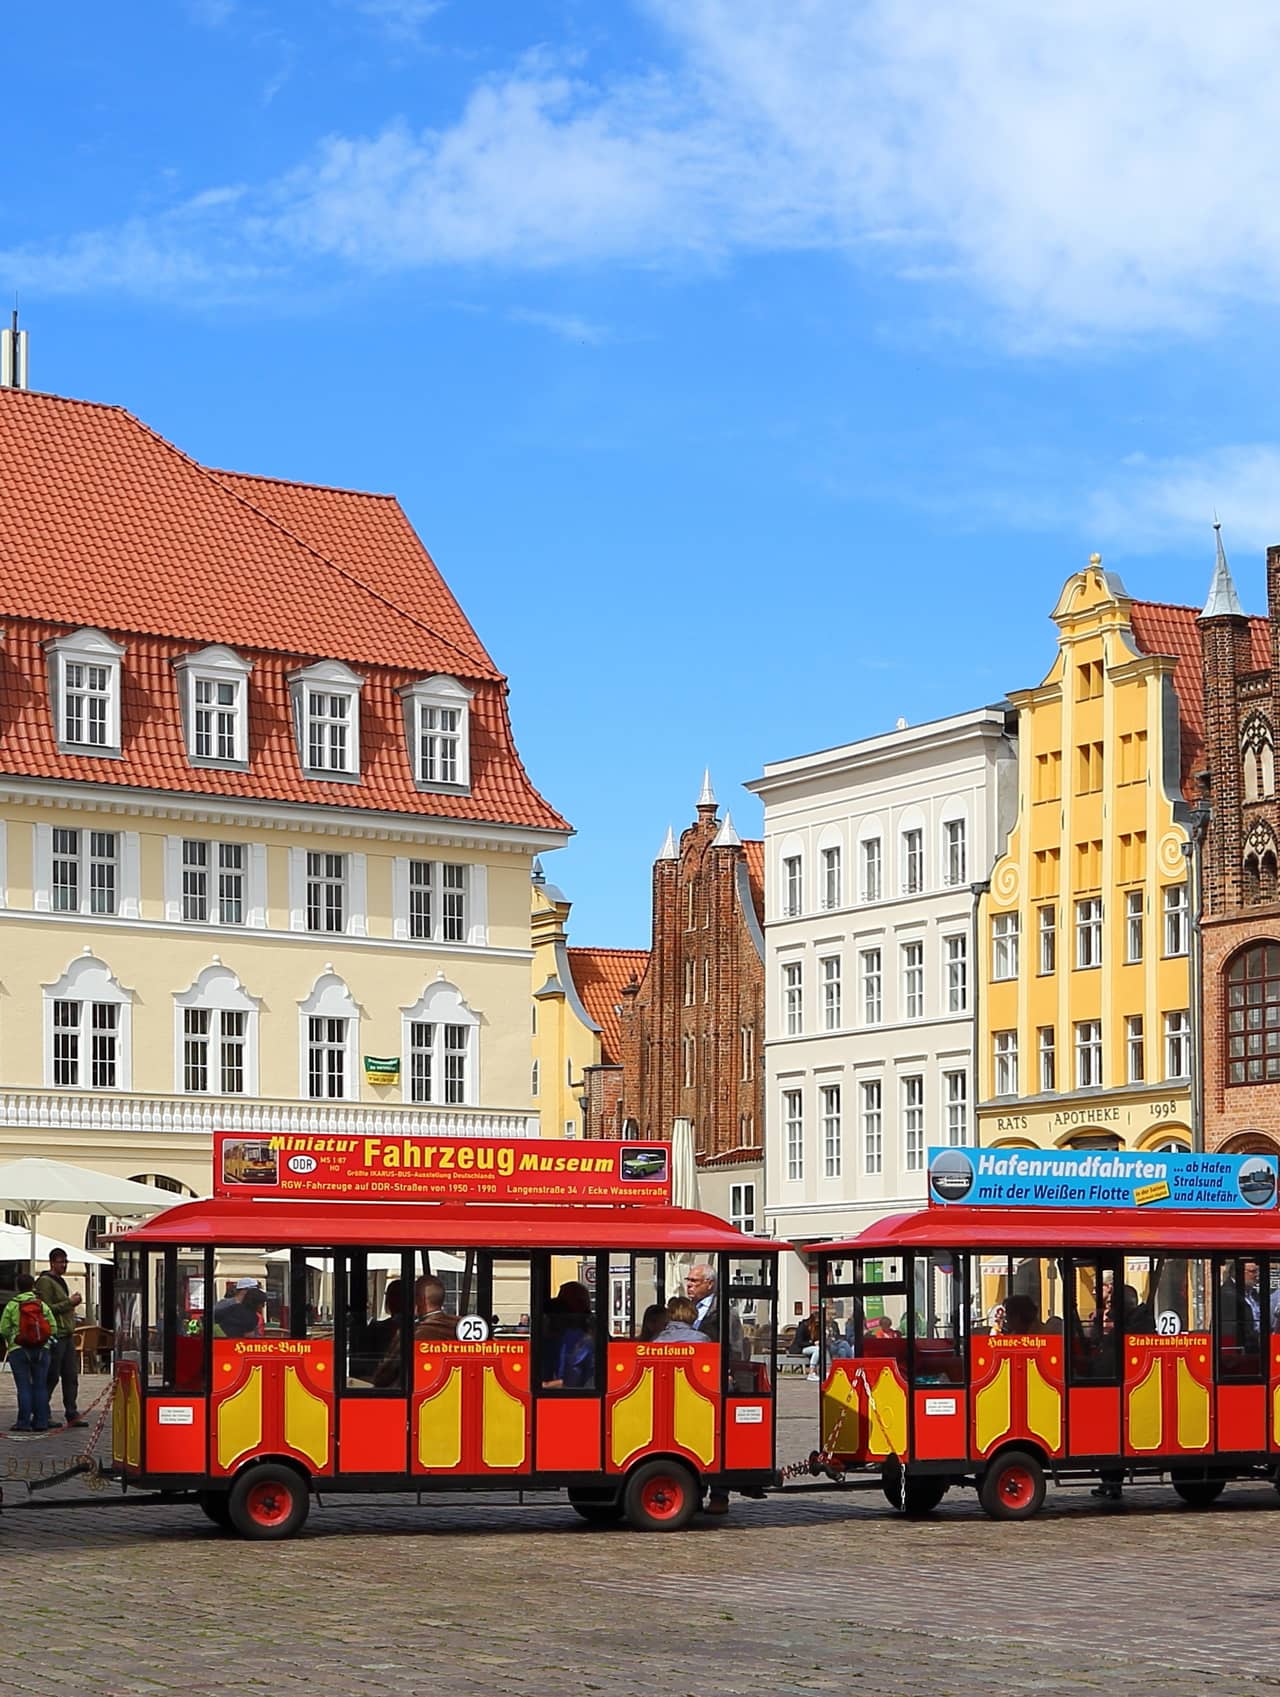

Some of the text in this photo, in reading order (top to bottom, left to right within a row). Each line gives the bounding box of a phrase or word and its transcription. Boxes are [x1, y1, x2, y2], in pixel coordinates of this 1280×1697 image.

[997, 1100, 1177, 1131] RATS APOTHEKE 1998
[269, 1136, 615, 1176] Miniatur Fahrzeug Museum
[293, 1158, 313, 1170] DDR
[978, 1154, 1167, 1179] Hafenrundfahrten
[1186, 1161, 1199, 1172] ab
[1201, 1162, 1232, 1174] Hafen
[453, 1172, 495, 1180] Deutschlands
[1173, 1175, 1223, 1188] Stralsund
[281, 1181, 352, 1192] RGW-Fahrzeuge
[354, 1182, 369, 1191] auf
[371, 1182, 428, 1192] DDR-Straßen
[430, 1185, 446, 1193] von
[448, 1184, 468, 1193] 1950
[477, 1184, 497, 1193] 1990
[507, 1185, 564, 1196] Langenstraße
[588, 1186, 608, 1195] Ecke
[610, 1187, 668, 1197] Wasserstraße
[979, 1184, 1003, 1199] mit
[1006, 1184, 1031, 1199] der
[1034, 1184, 1085, 1200] Weißen
[1089, 1185, 1130, 1200] Flotte
[1174, 1190, 1195, 1201] und
[1196, 1190, 1238, 1203] Altefähr
[462, 1321, 483, 1340] 25
[1161, 1316, 1176, 1335] 25
[234, 1341, 311, 1355] Hanse-Bahn
[987, 1336, 1047, 1348] Hanse-Bahn
[1128, 1336, 1208, 1347] Stadtrundfahrten
[420, 1342, 524, 1355] Stadtrundfahrten
[636, 1344, 695, 1356] Stralsund
